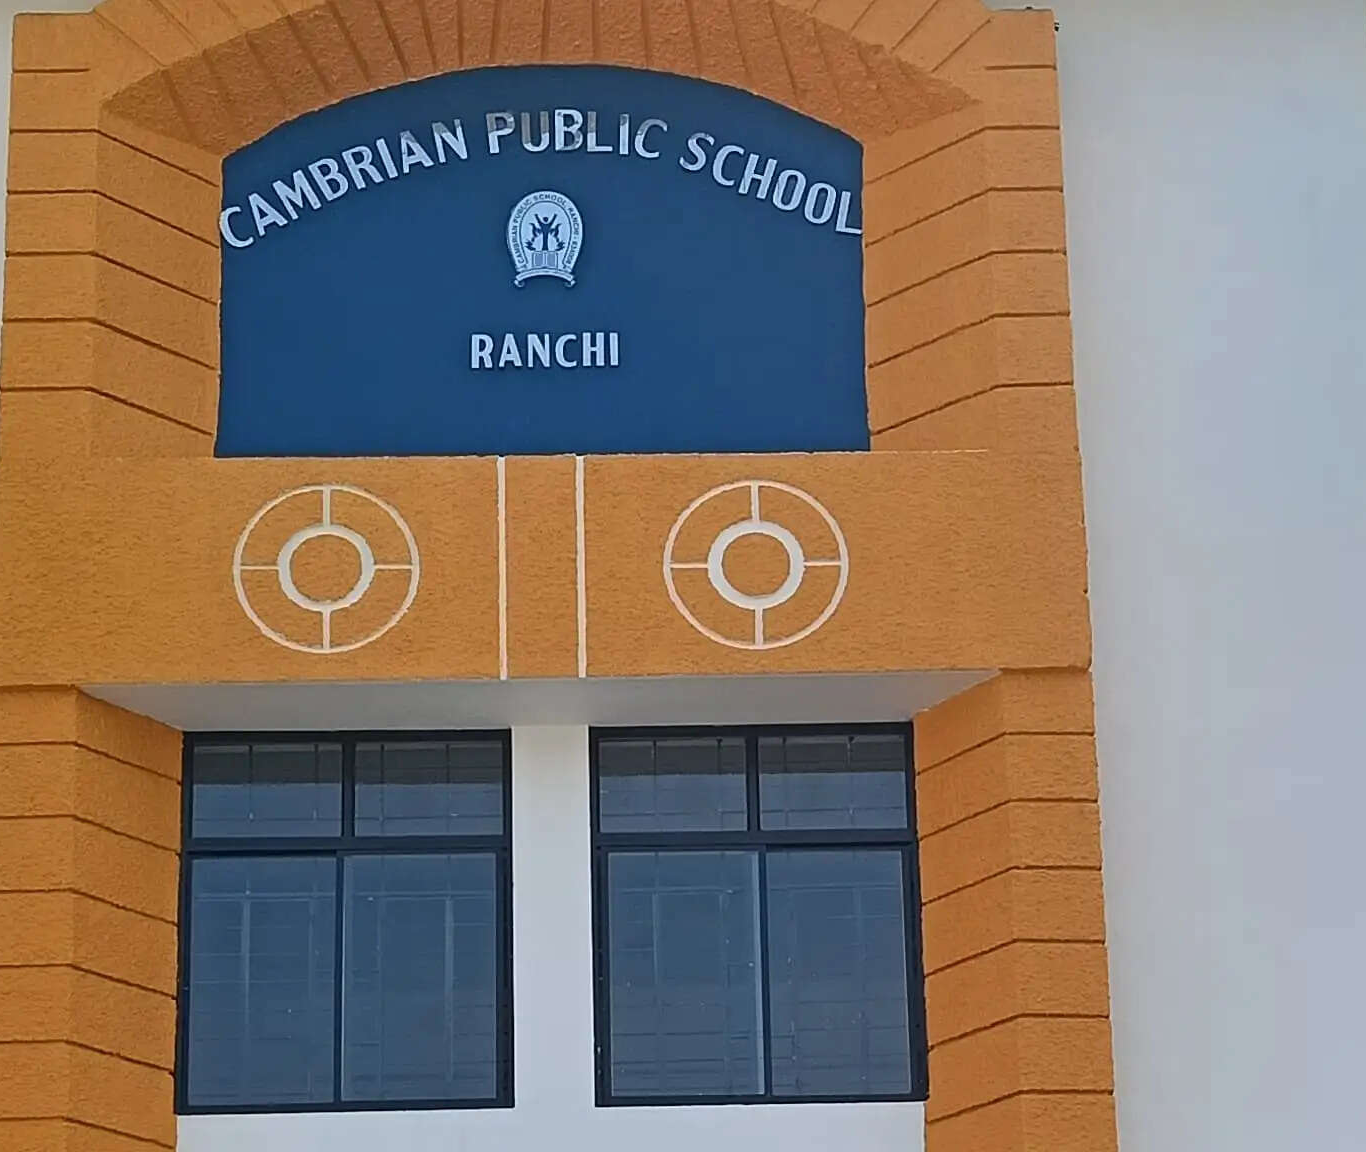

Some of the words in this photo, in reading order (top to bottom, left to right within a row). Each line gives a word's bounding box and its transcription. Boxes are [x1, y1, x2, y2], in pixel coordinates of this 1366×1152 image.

[218, 118, 468, 248] CAMBRIAN
[485, 108, 668, 159] PUBLIC
[679, 132, 863, 235] SCHOOL
[470, 332, 619, 369] RANCHI
